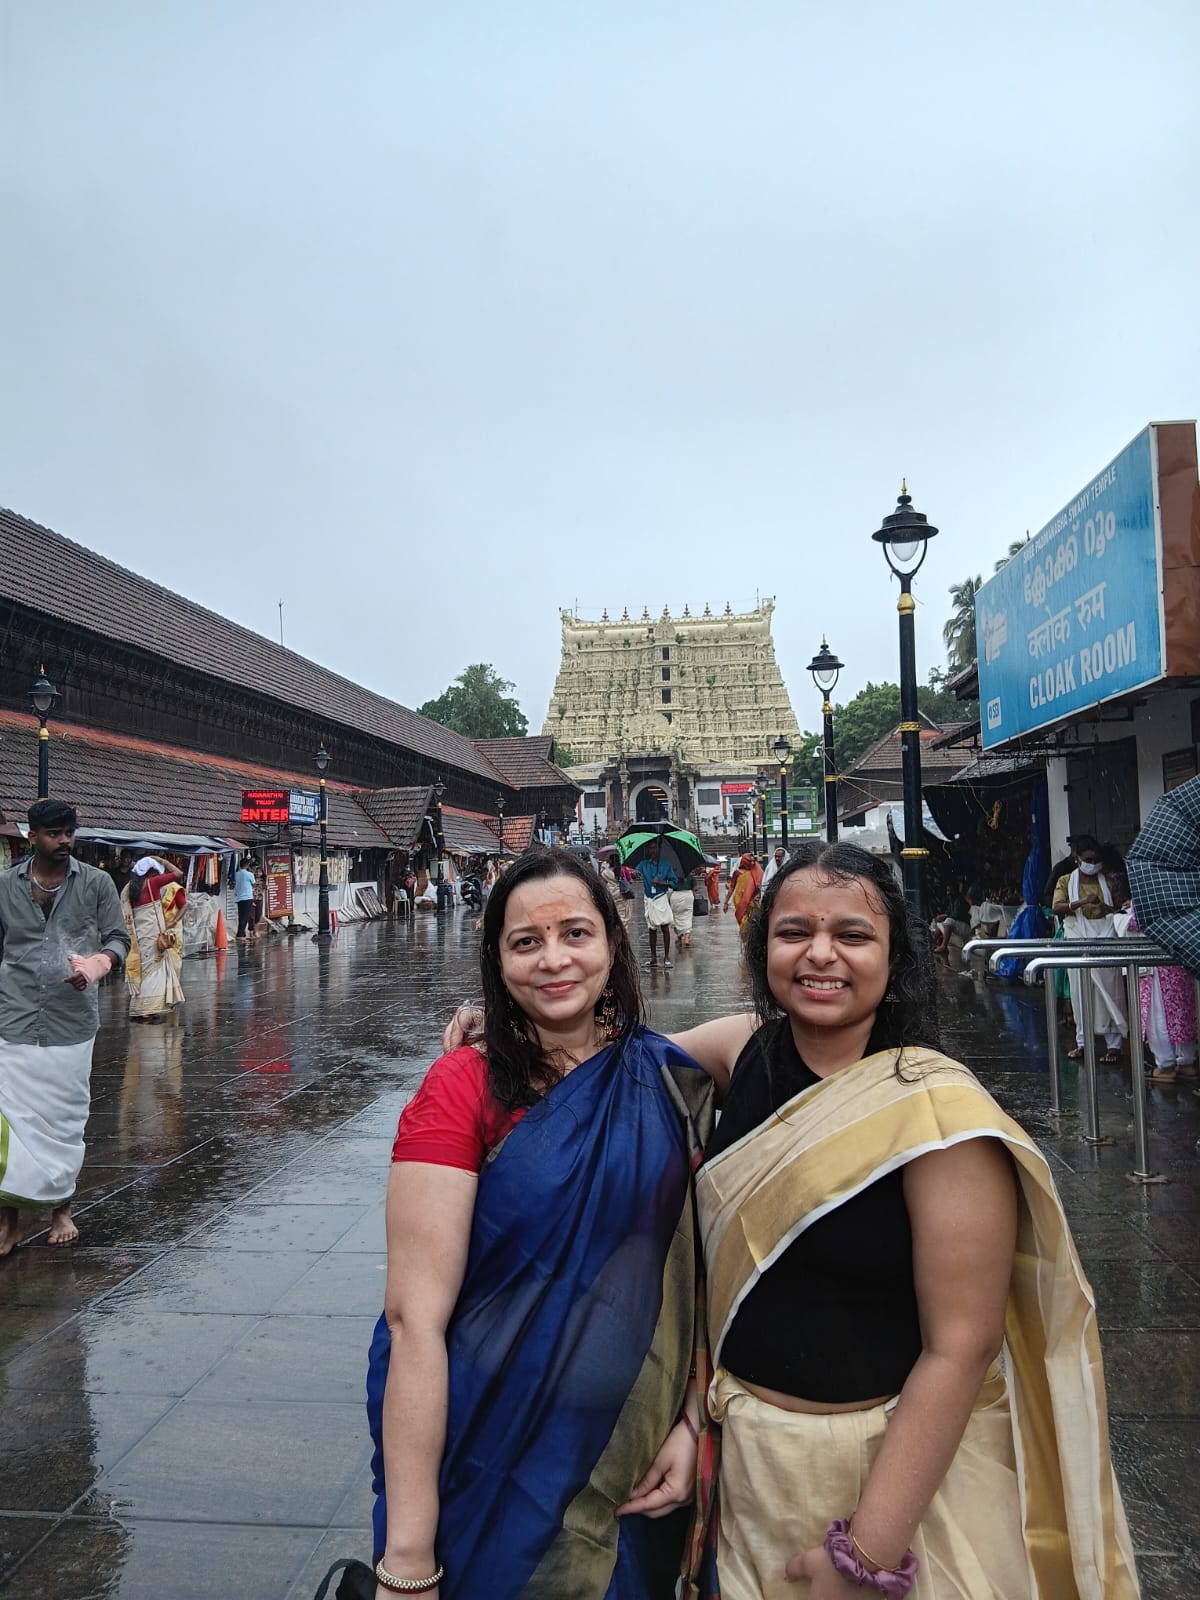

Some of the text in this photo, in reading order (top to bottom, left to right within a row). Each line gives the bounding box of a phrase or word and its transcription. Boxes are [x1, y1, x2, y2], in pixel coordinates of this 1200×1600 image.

[1068, 491, 1090, 521] SWAMY
[1090, 466, 1116, 501] TEMPLE
[1027, 605, 1071, 660] क्लोक
[1029, 621, 1137, 709] CLOAK ROOM
[242, 808, 289, 821] ENTER
